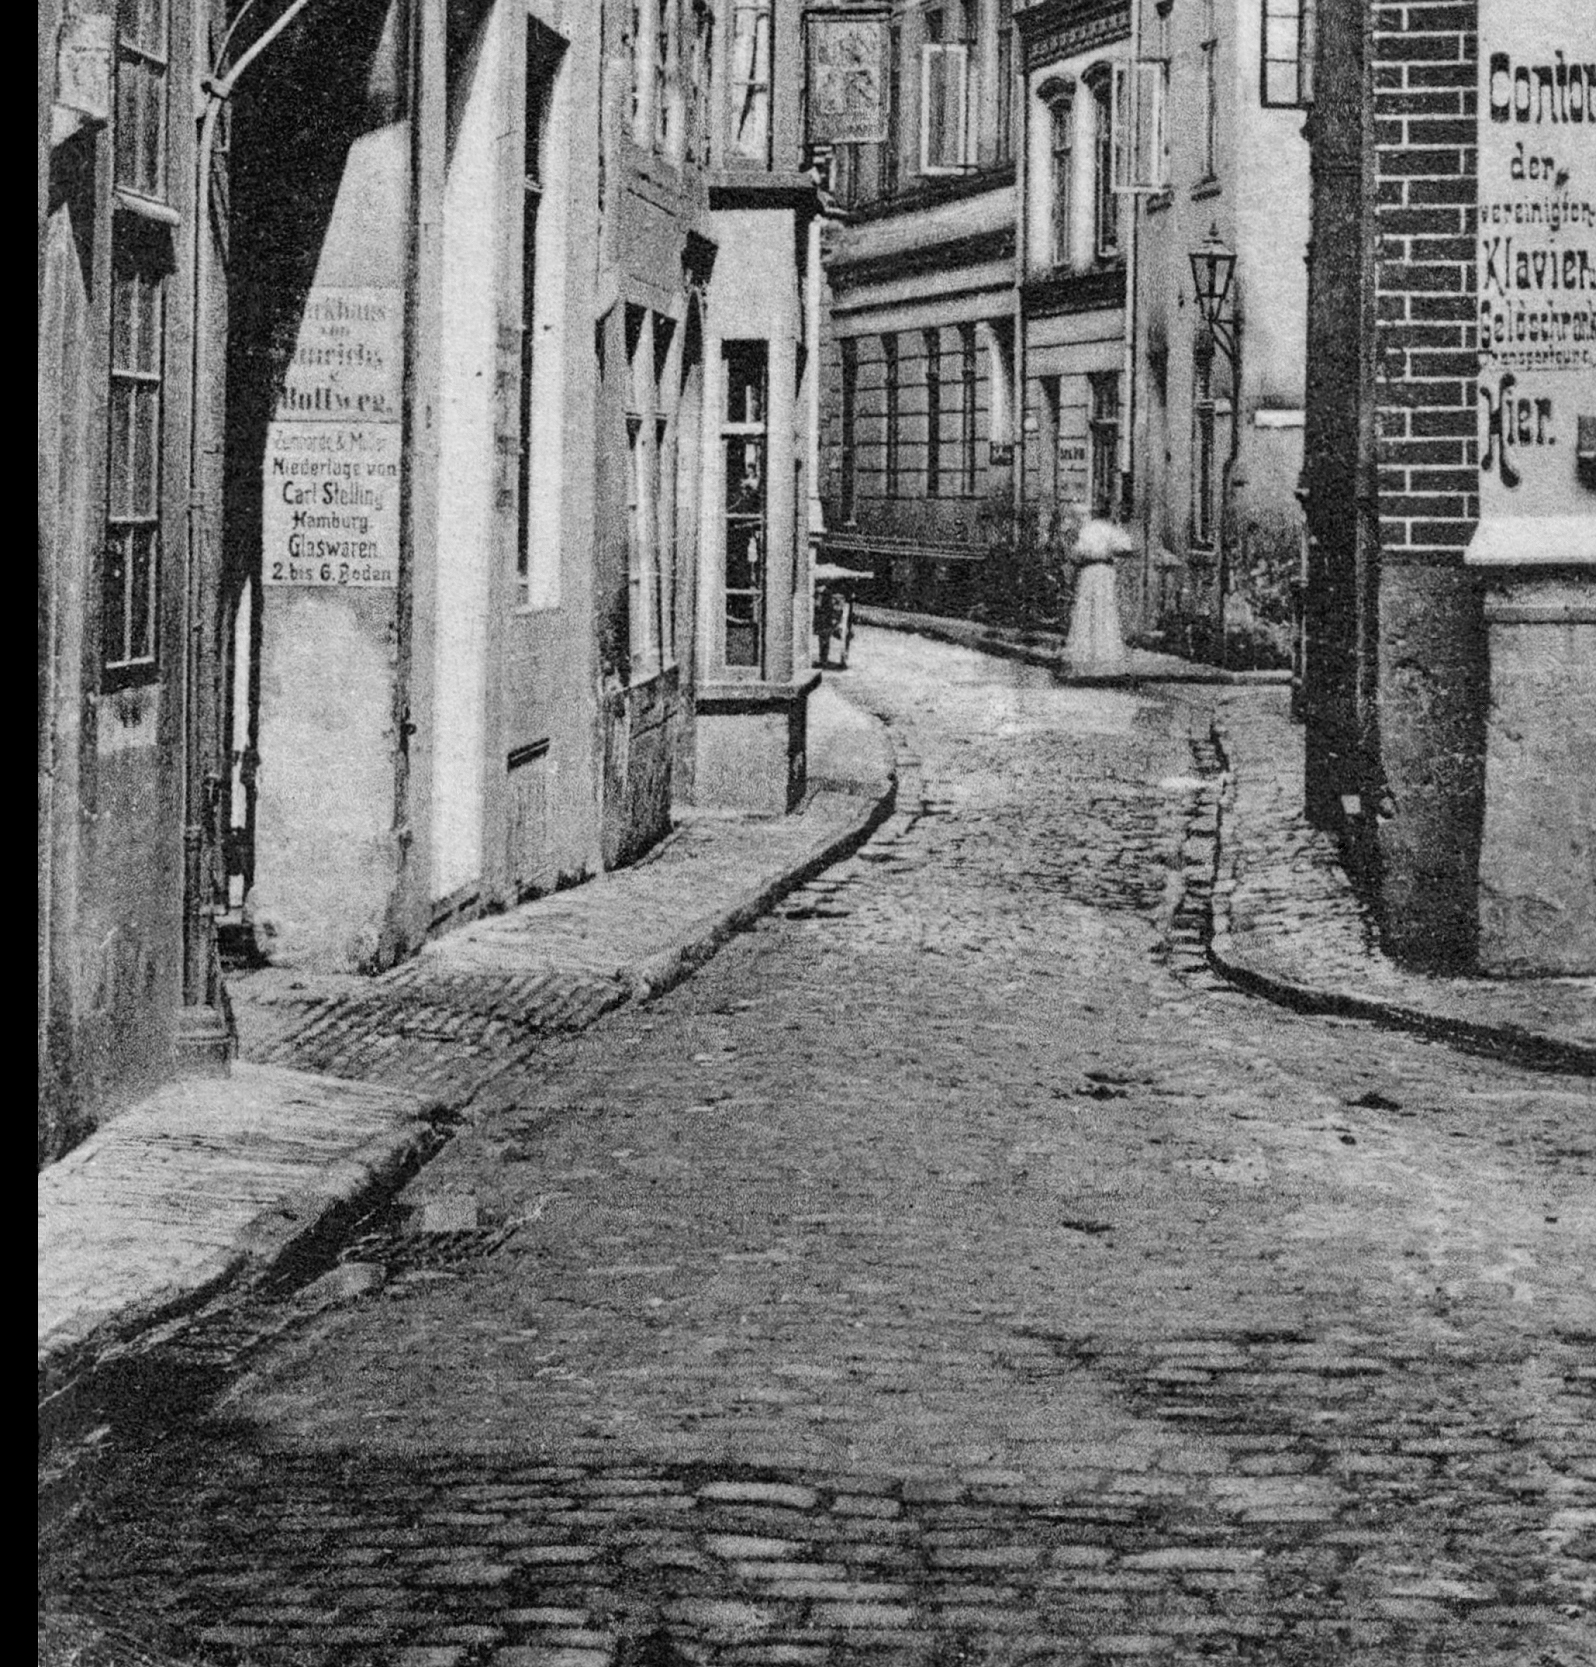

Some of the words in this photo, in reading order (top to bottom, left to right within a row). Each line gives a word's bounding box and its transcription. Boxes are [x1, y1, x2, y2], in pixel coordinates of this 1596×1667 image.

[1510, 141, 1554, 180] der
[1479, 372, 1556, 489] Hier.
[272, 457, 361, 479] Niederlage
[282, 480, 317, 505] Carl
